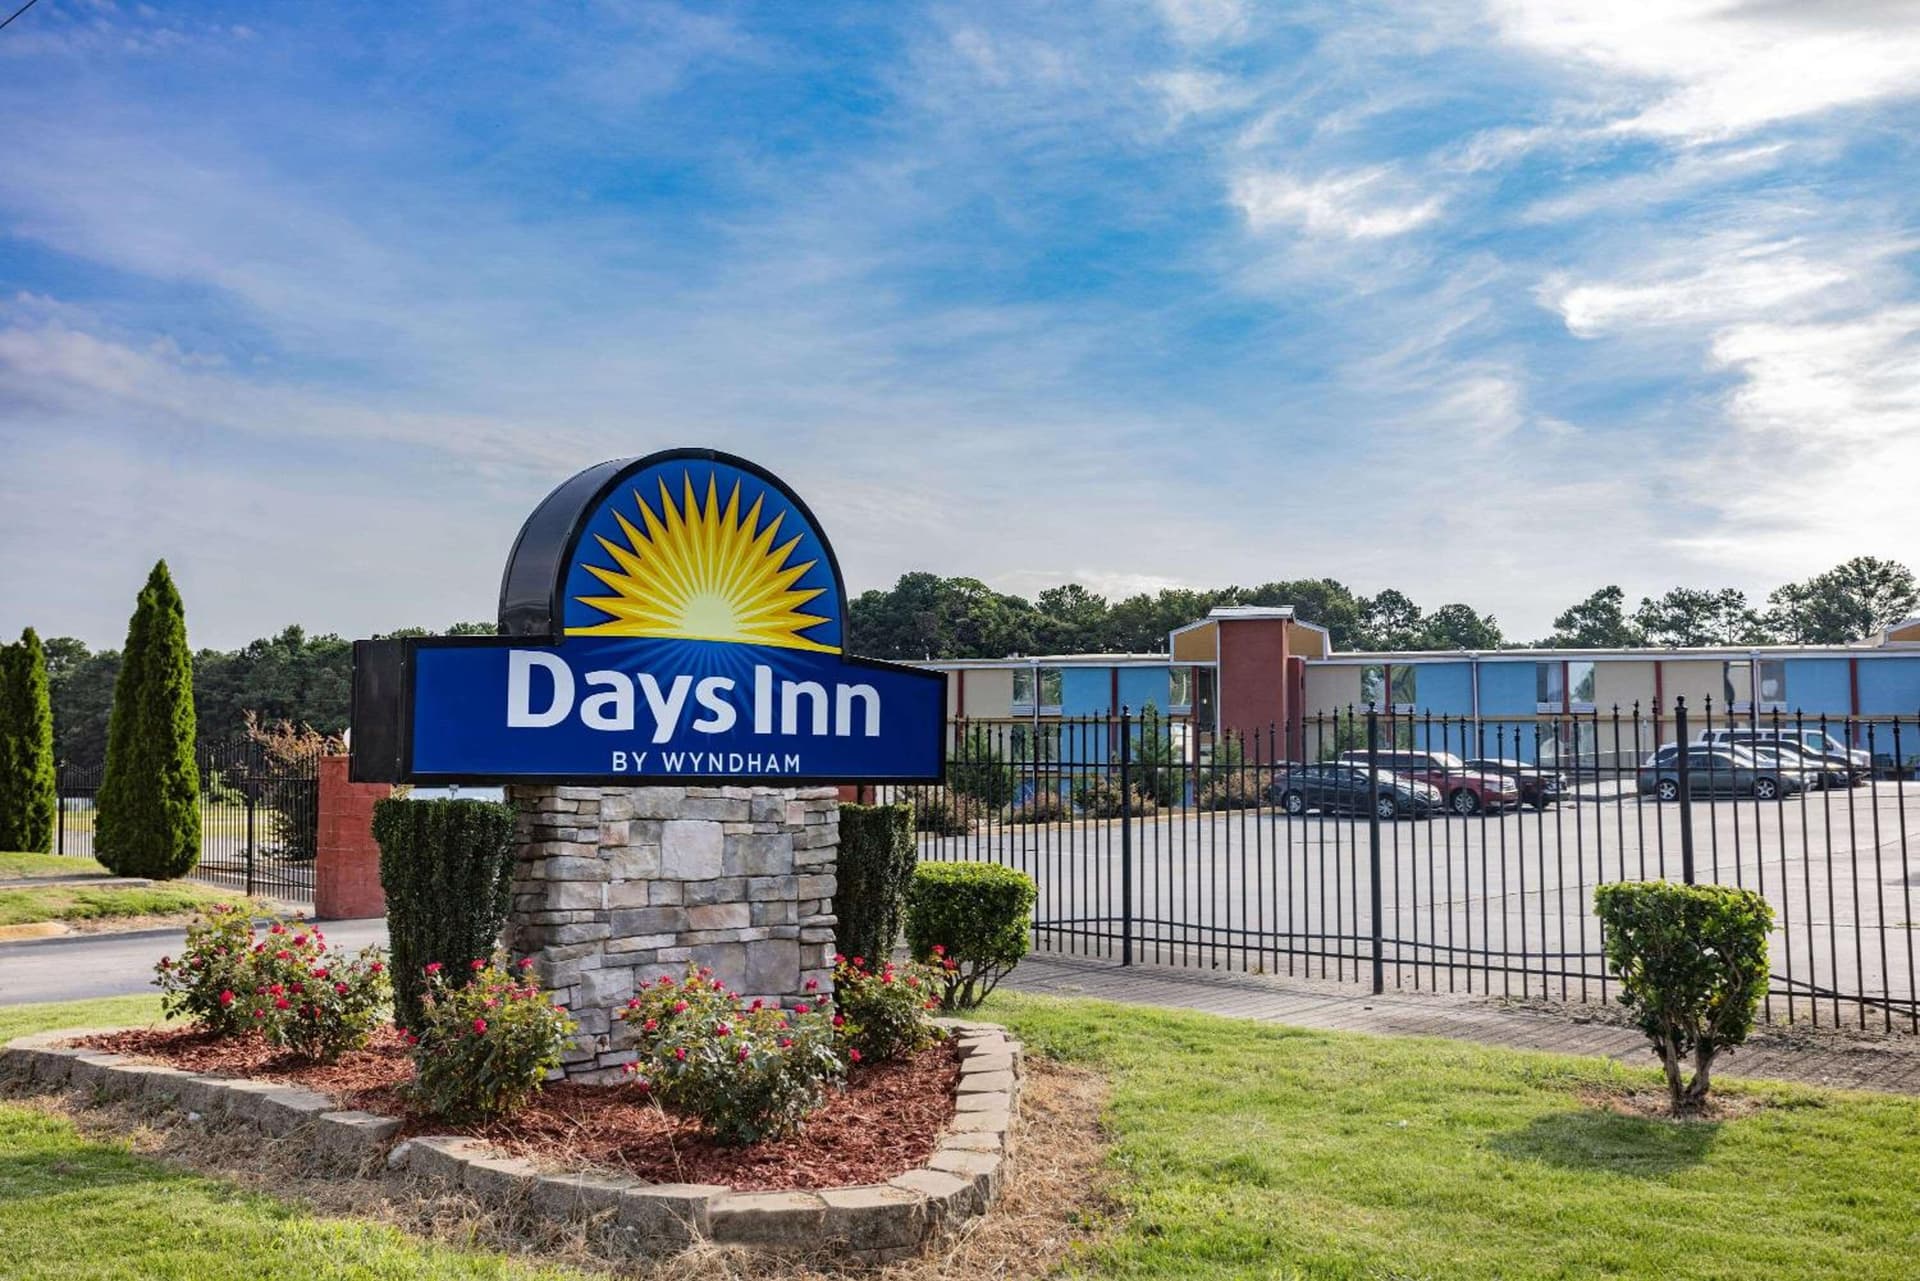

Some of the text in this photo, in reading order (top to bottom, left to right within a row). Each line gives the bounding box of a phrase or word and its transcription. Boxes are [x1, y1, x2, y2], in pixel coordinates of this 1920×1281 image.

[507, 649, 881, 744] Days Inn
[612, 751, 801, 773] BY WYNDHAM
